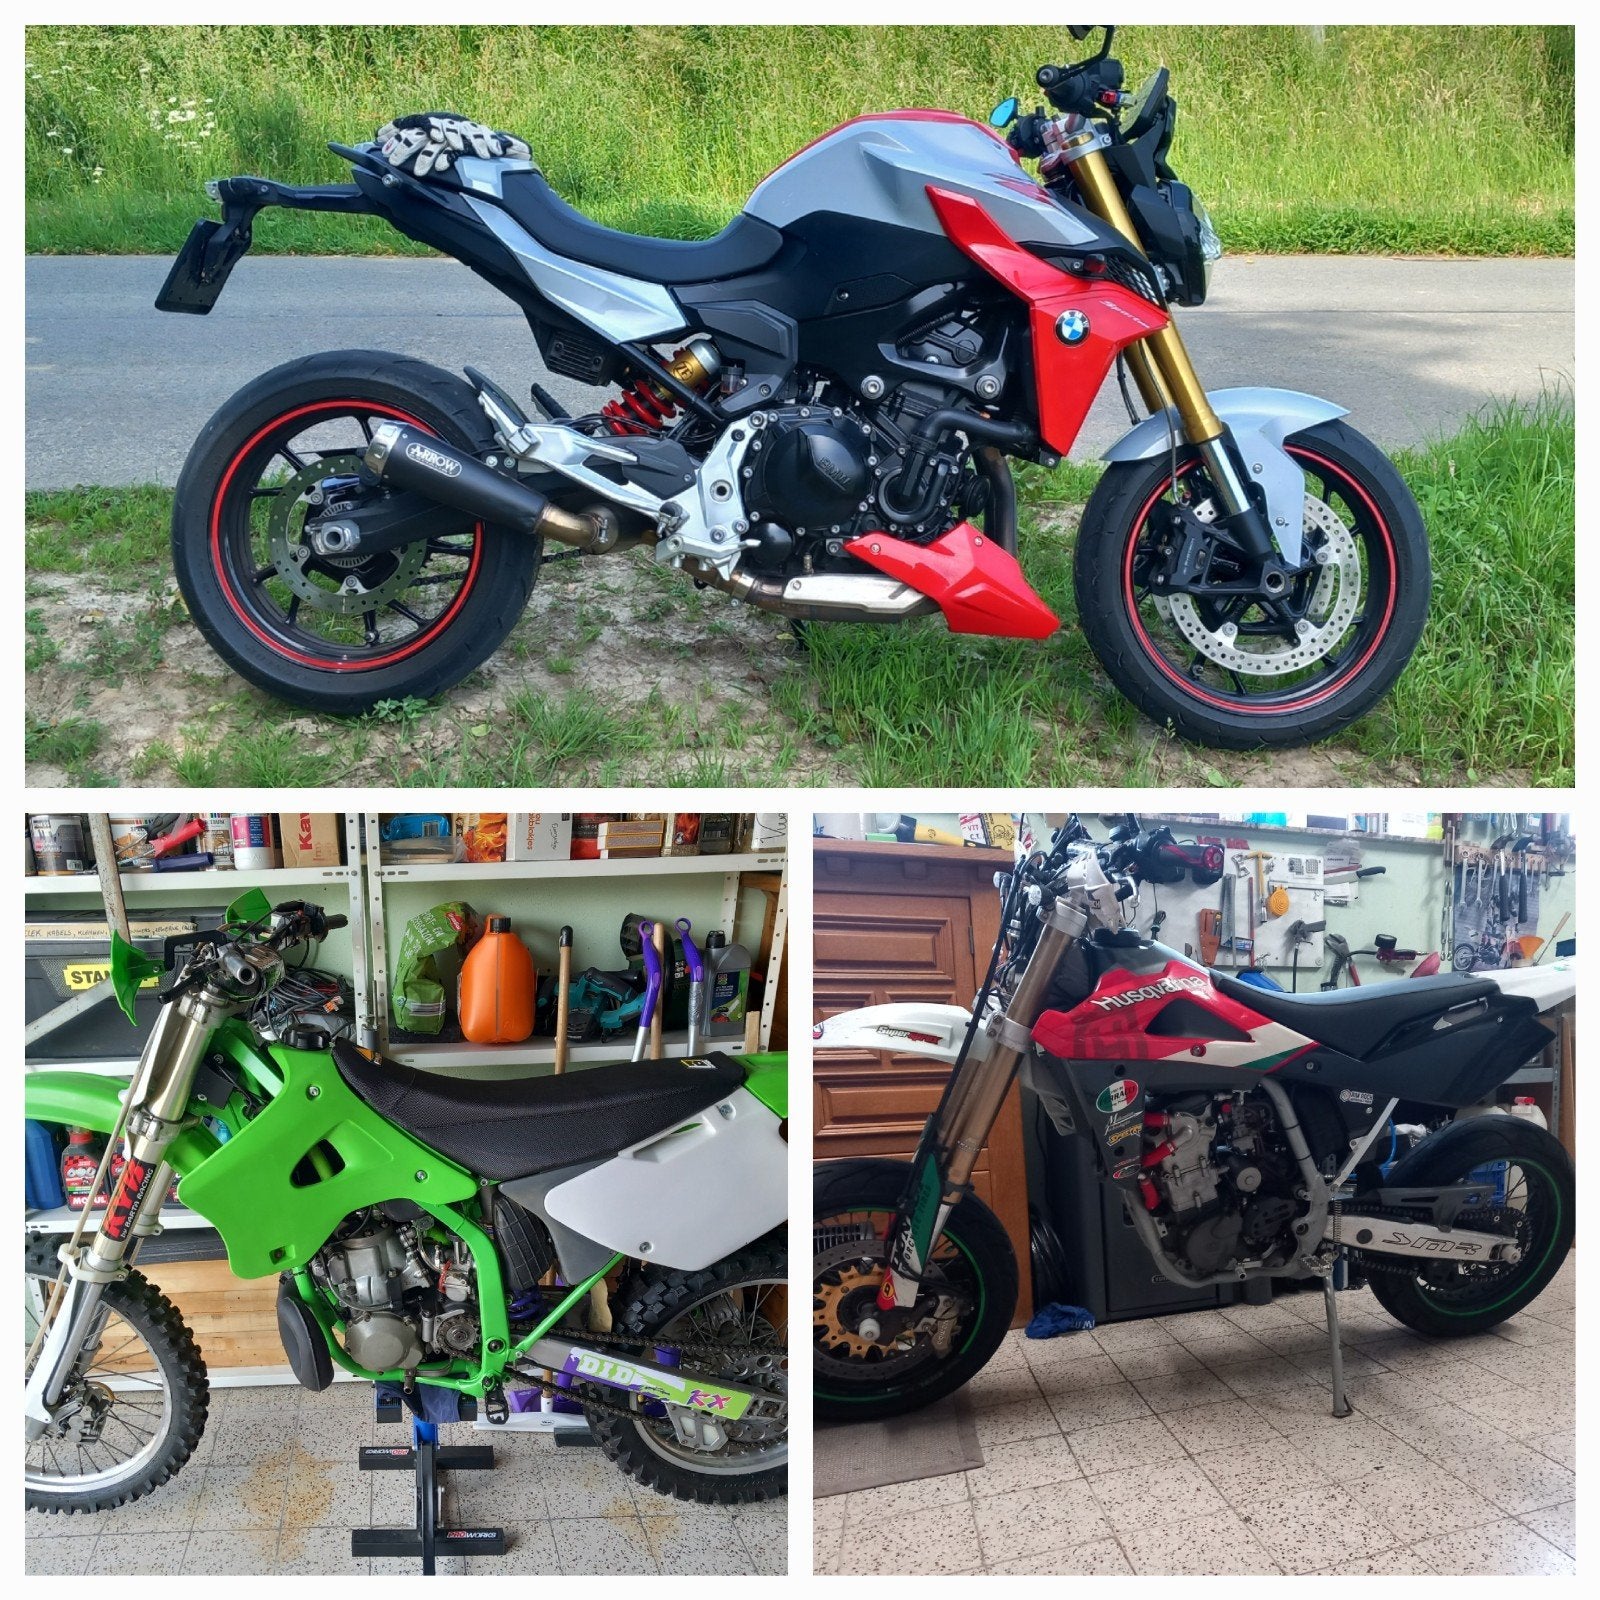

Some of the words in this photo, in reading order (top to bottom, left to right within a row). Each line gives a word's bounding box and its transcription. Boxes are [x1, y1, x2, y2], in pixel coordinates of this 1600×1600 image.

[410, 445, 459, 472] ARROW
[1091, 975, 1206, 1011] Husqvarna
[72, 1196, 107, 1205] MOUL
[124, 1201, 140, 1229] BARTA
[136, 1168, 154, 1201] RACING
[686, 1389, 732, 1411] KX
[446, 1531, 497, 1539] PROWORKS
